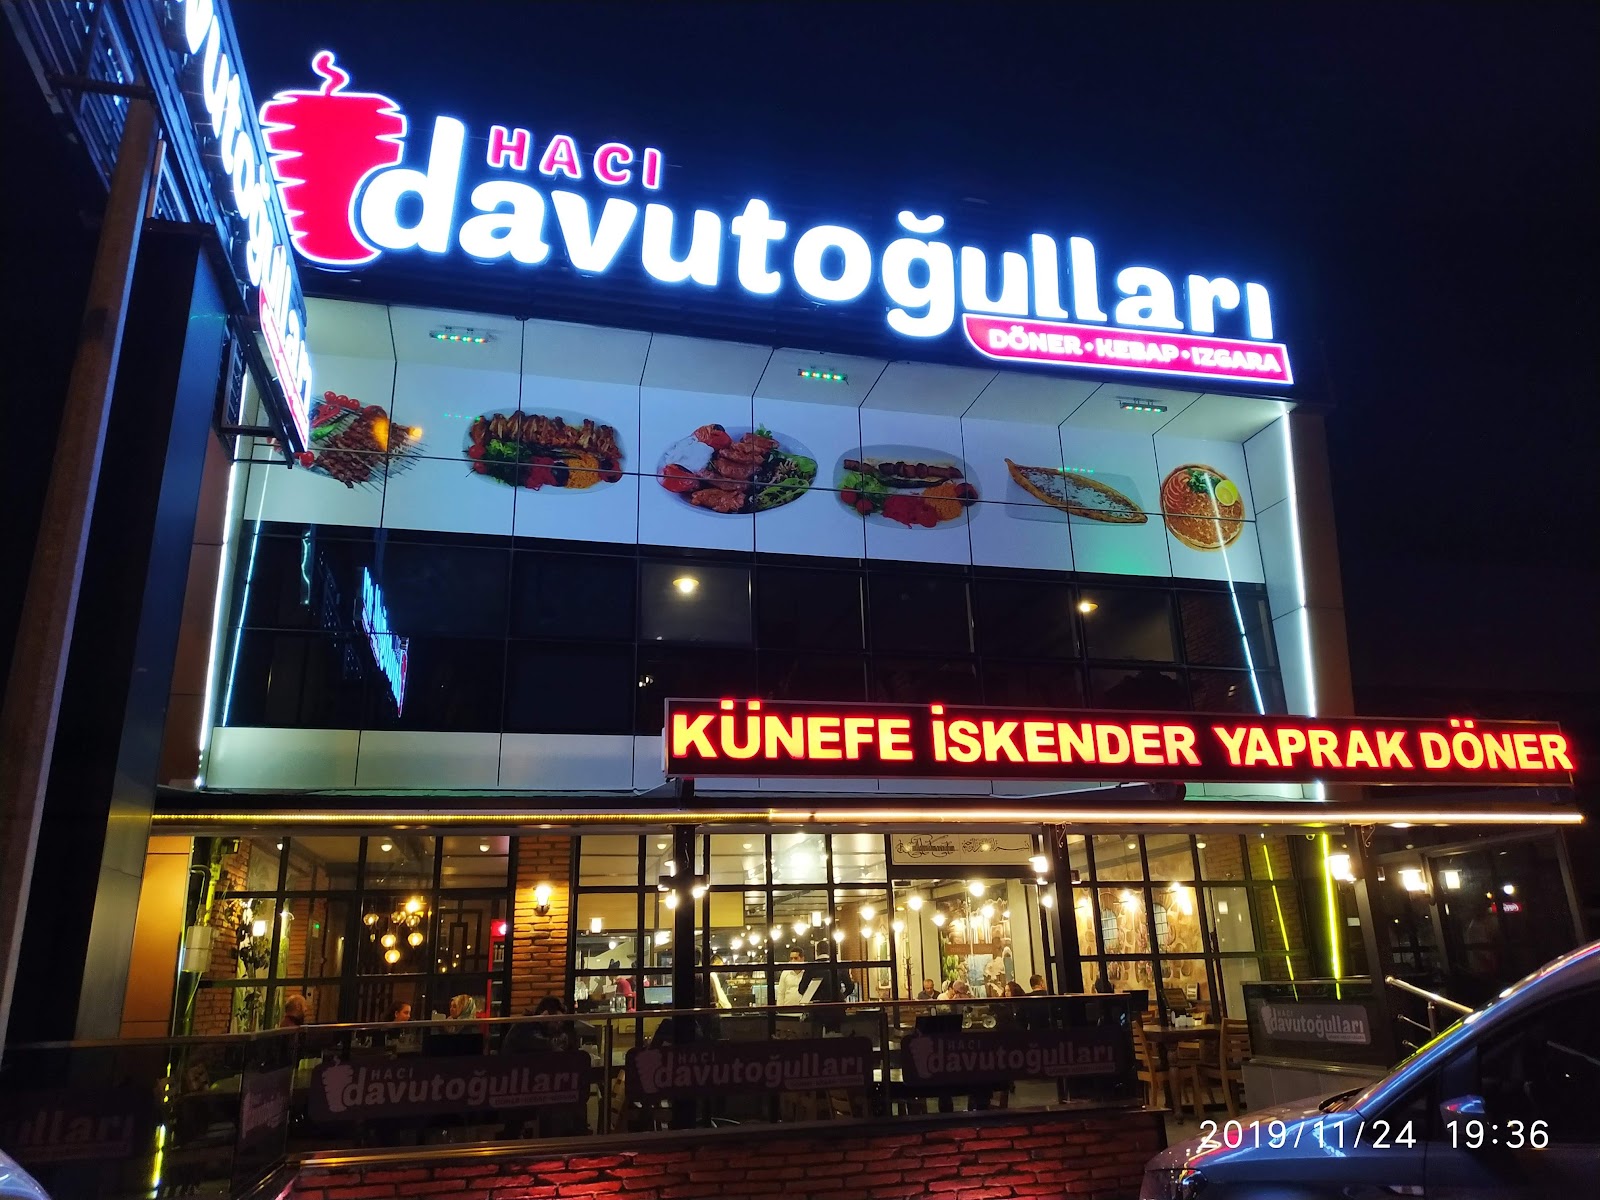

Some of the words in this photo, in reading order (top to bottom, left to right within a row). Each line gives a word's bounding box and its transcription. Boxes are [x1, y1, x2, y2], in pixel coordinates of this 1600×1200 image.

[486, 125, 662, 190] HACI
[360, 115, 1275, 340] davutoğulları
[988, 326, 1083, 355] DÖNER
[1096, 338, 1180, 363] KEBAP
[1191, 347, 1282, 373] IZGARA
[672, 699, 914, 761] KÜNEFE
[931, 704, 1202, 766] İSKENDER
[1212, 726, 1414, 769] YAPRAK
[1420, 718, 1575, 770] DÖNER
[1270, 1007, 1364, 1038] davutoğulları
[370, 1067, 414, 1080] HACI
[654, 1051, 864, 1088] davutoğulları
[928, 1038, 1114, 1074] davutoğulları
[343, 1066, 580, 1106] davutoğulları
